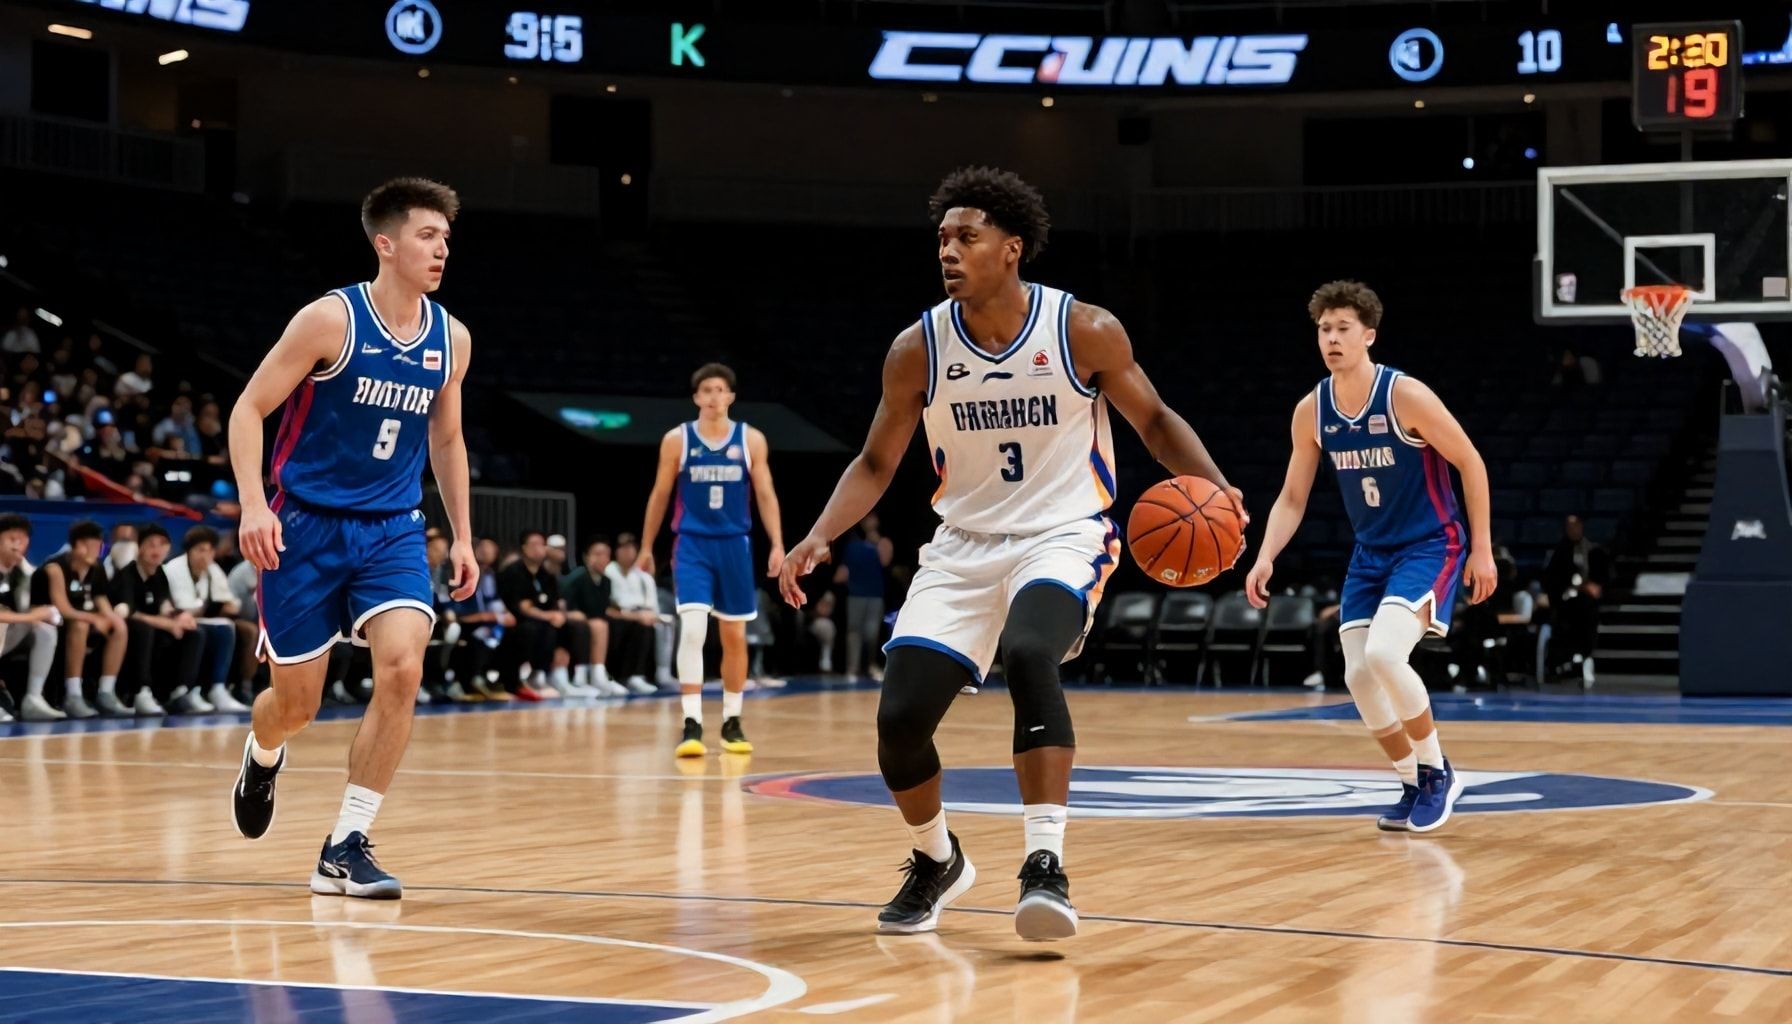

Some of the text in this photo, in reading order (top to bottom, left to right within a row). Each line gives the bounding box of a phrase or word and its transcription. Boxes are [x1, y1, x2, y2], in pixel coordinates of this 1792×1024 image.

[671, 22, 706, 67] K
[1517, 29, 1561, 74] 10
[998, 441, 1024, 483] 3
